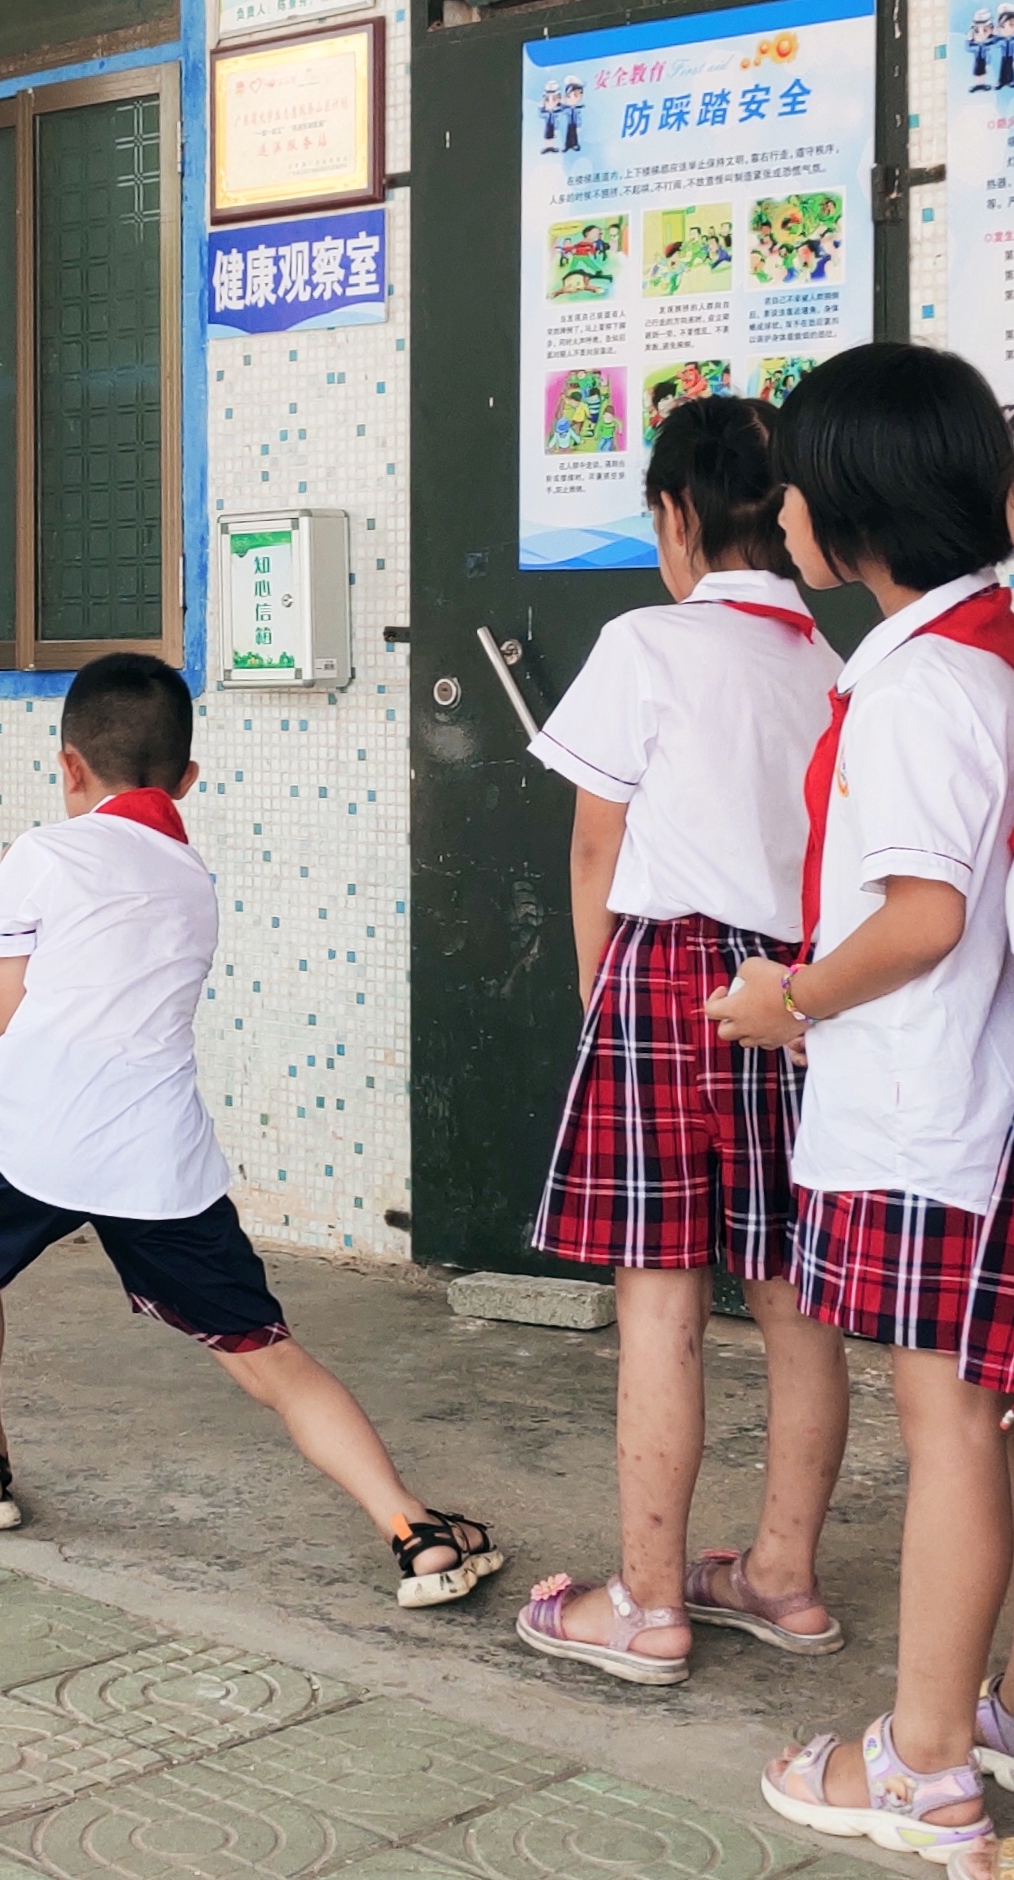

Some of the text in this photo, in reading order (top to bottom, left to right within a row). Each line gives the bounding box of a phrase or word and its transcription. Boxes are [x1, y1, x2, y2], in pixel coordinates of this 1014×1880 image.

[594, 60, 667, 91] 安全教育
[621, 77, 813, 138] 防踩踏安全
[211, 231, 381, 313] 健康观察室
[253, 556, 273, 646] 知心信箱
